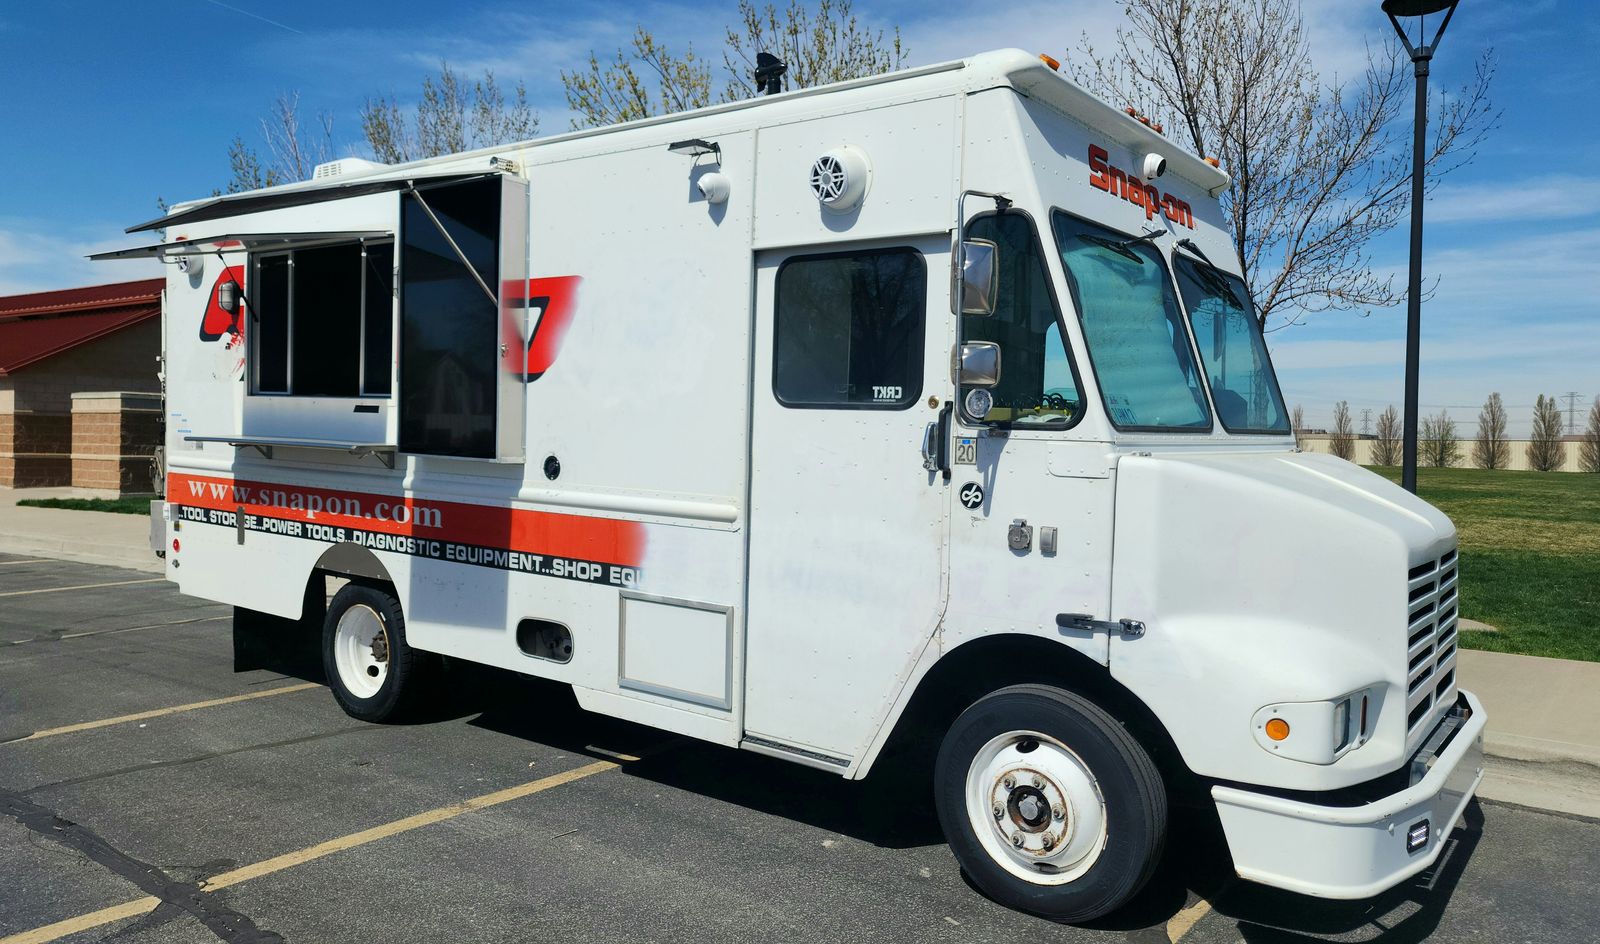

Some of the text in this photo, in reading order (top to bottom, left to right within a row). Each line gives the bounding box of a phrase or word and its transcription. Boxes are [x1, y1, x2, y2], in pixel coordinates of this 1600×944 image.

[1088, 143, 1194, 230] Snap-on
[958, 444, 975, 463] 20
[188, 480, 443, 528] www.snapon.com
